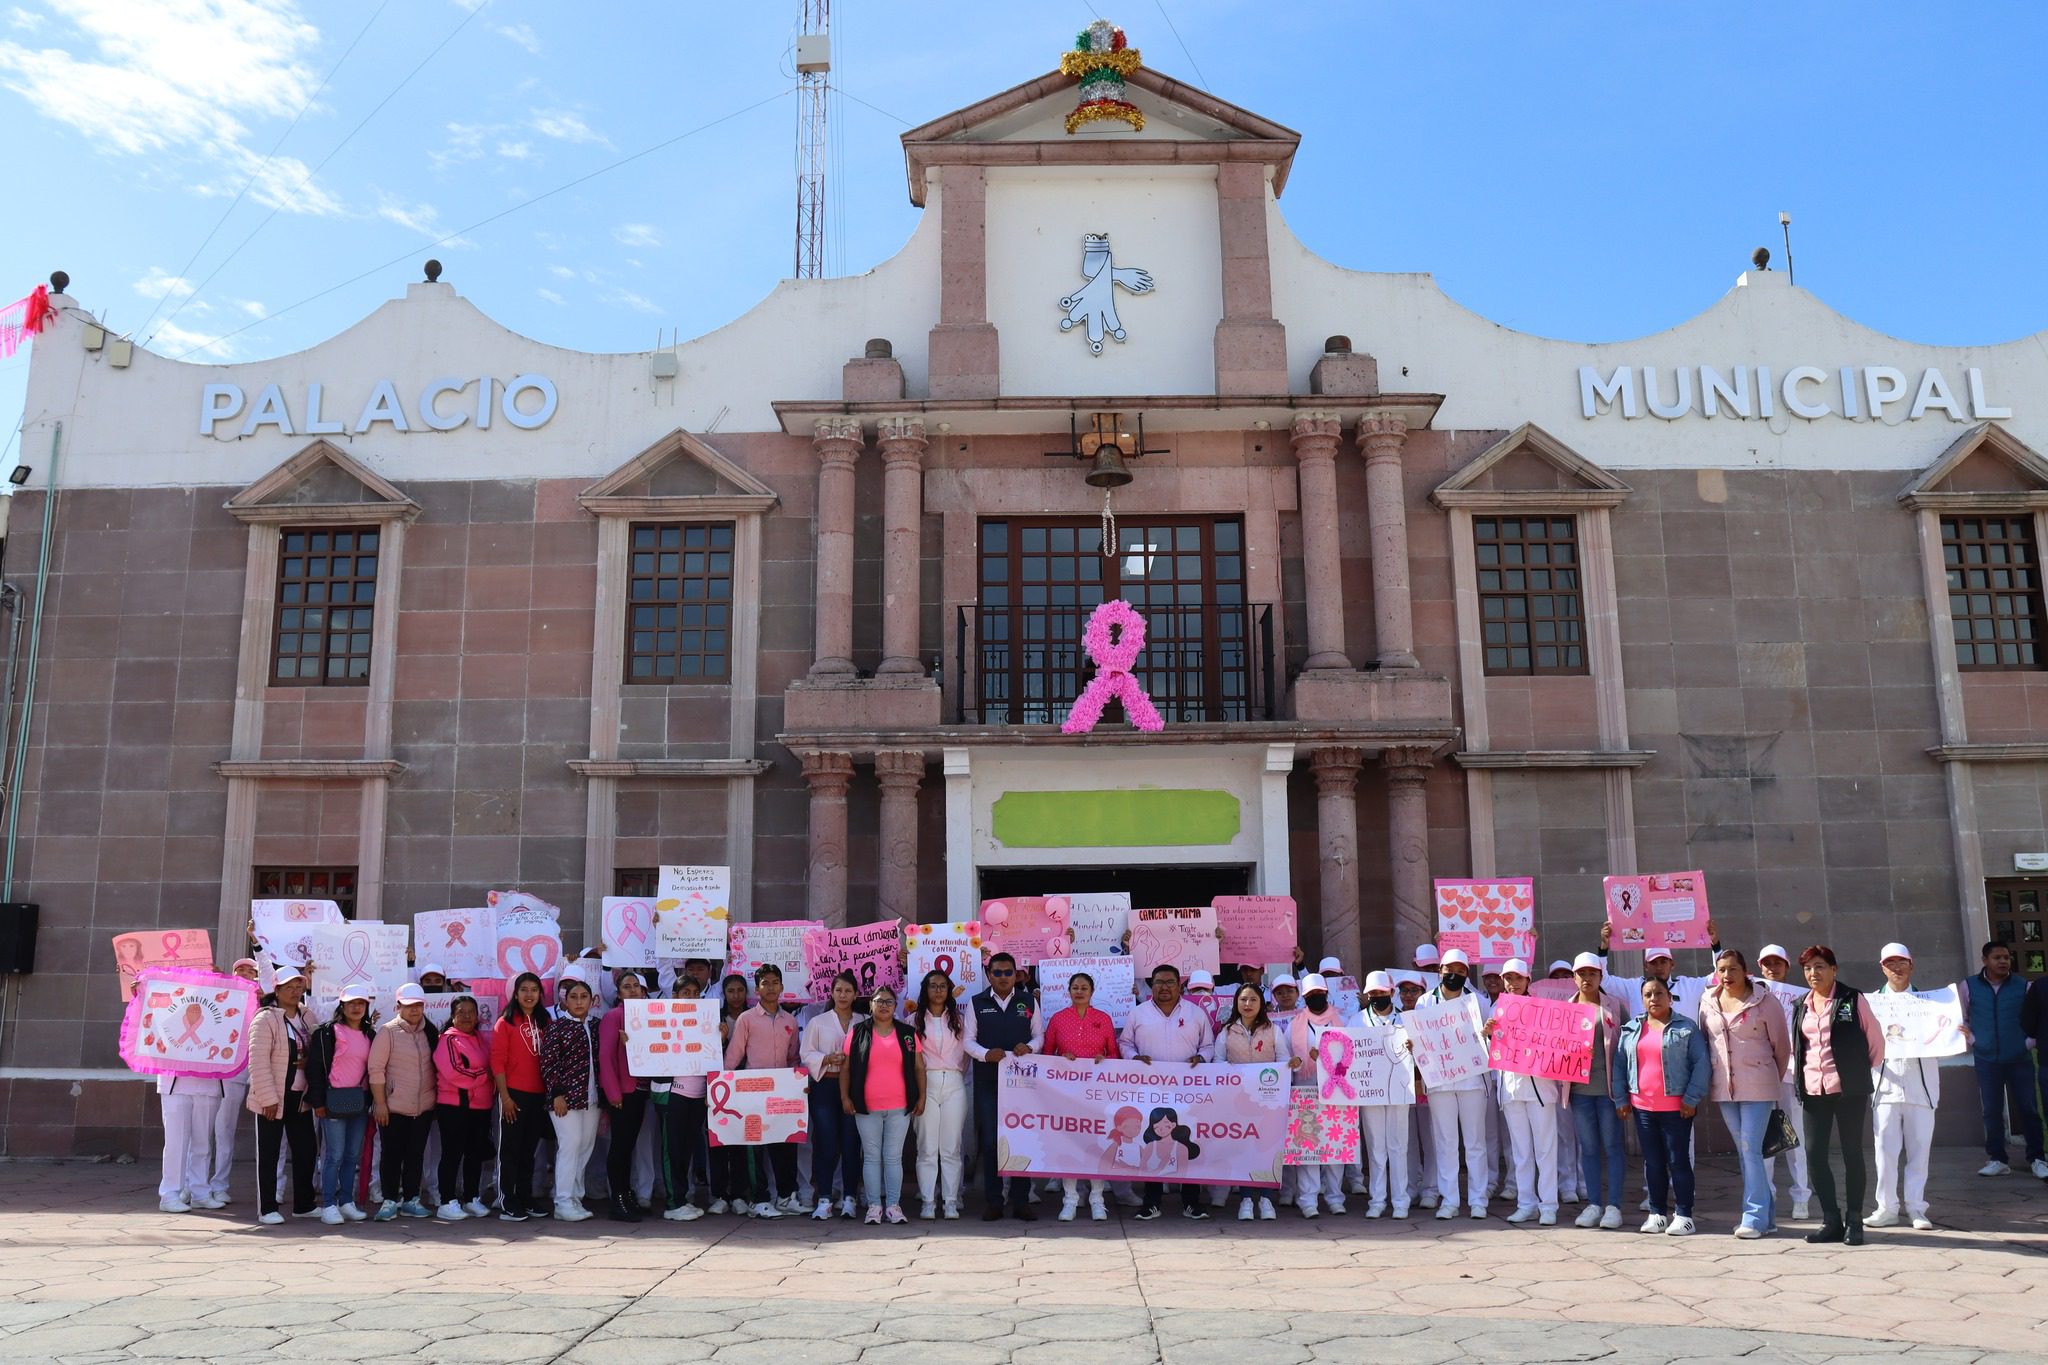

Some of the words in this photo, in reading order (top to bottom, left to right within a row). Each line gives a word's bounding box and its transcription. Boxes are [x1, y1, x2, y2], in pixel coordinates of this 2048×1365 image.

[1578, 365, 2012, 421] MUNICIPAL
[200, 373, 559, 437] PALACIO
[673, 867, 683, 875] No
[1139, 909, 1168, 921] CANCER
[1174, 908, 1202, 919] MAMA
[1506, 1025, 1527, 1042] MES
[1532, 1031, 1548, 1046] DEL
[1506, 1048, 1520, 1064] DE
[1046, 1069, 1092, 1083] SMDIF
[1096, 1072, 1178, 1086] ALMOLOYA
[1183, 1075, 1211, 1087] DEL
[1215, 1073, 1241, 1086] RÍO
[1085, 1089, 1102, 1101] SE
[1107, 1090, 1145, 1103] VISTE
[1150, 1092, 1169, 1104] DE
[1174, 1093, 1214, 1104] ROSA
[1359, 1089, 1385, 1098] CUERPO
[1004, 1112, 1107, 1135] OCTUBRE
[1196, 1122, 1260, 1140] ROSA
